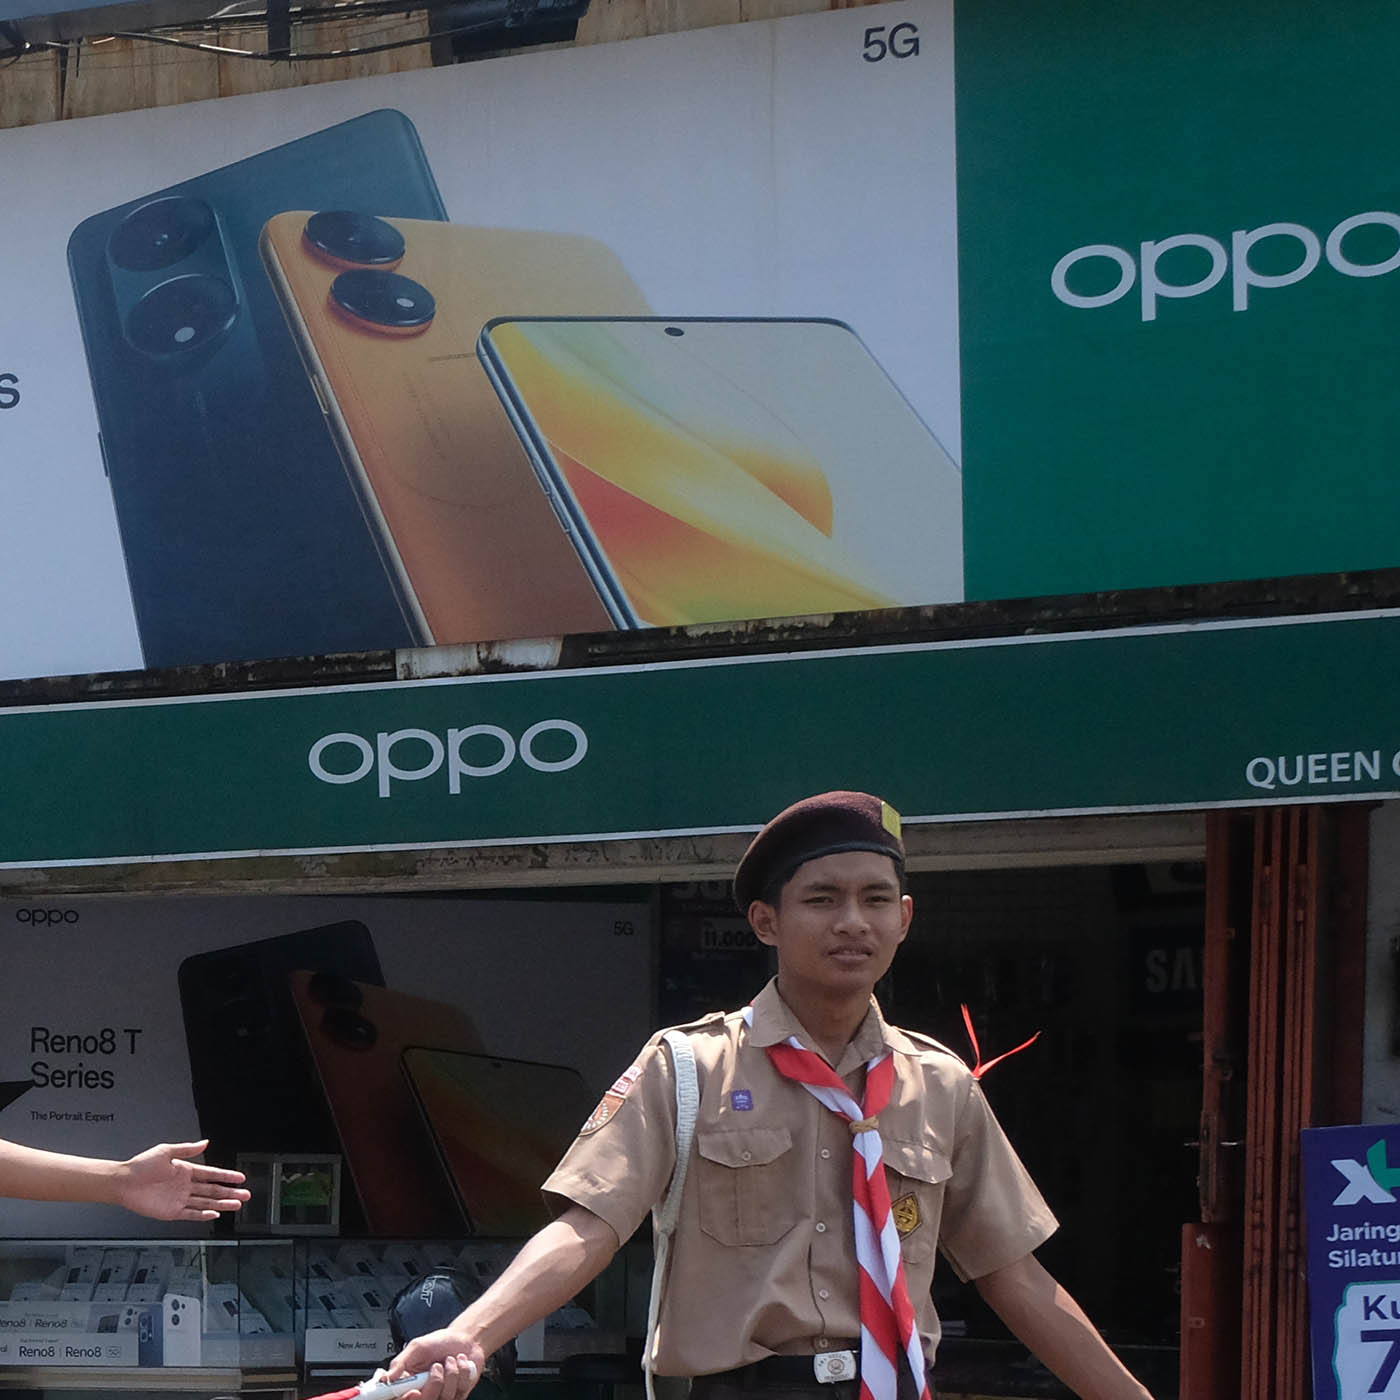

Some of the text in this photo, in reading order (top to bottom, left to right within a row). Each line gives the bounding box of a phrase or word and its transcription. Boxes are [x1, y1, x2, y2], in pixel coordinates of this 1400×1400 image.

[863, 22, 920, 63] 5G
[1050, 210, 1400, 322] oppo
[308, 719, 588, 798] oppo
[1245, 751, 1381, 790] QUEEN
[16, 908, 80, 928] oppo
[30, 1026, 143, 1055] Reno8 T
[30, 1061, 115, 1089] Series
[30, 1111, 115, 1123] The Portrait Expert
[19, 1346, 56, 1358] Reno8
[65, 1346, 103, 1358] Reno8
